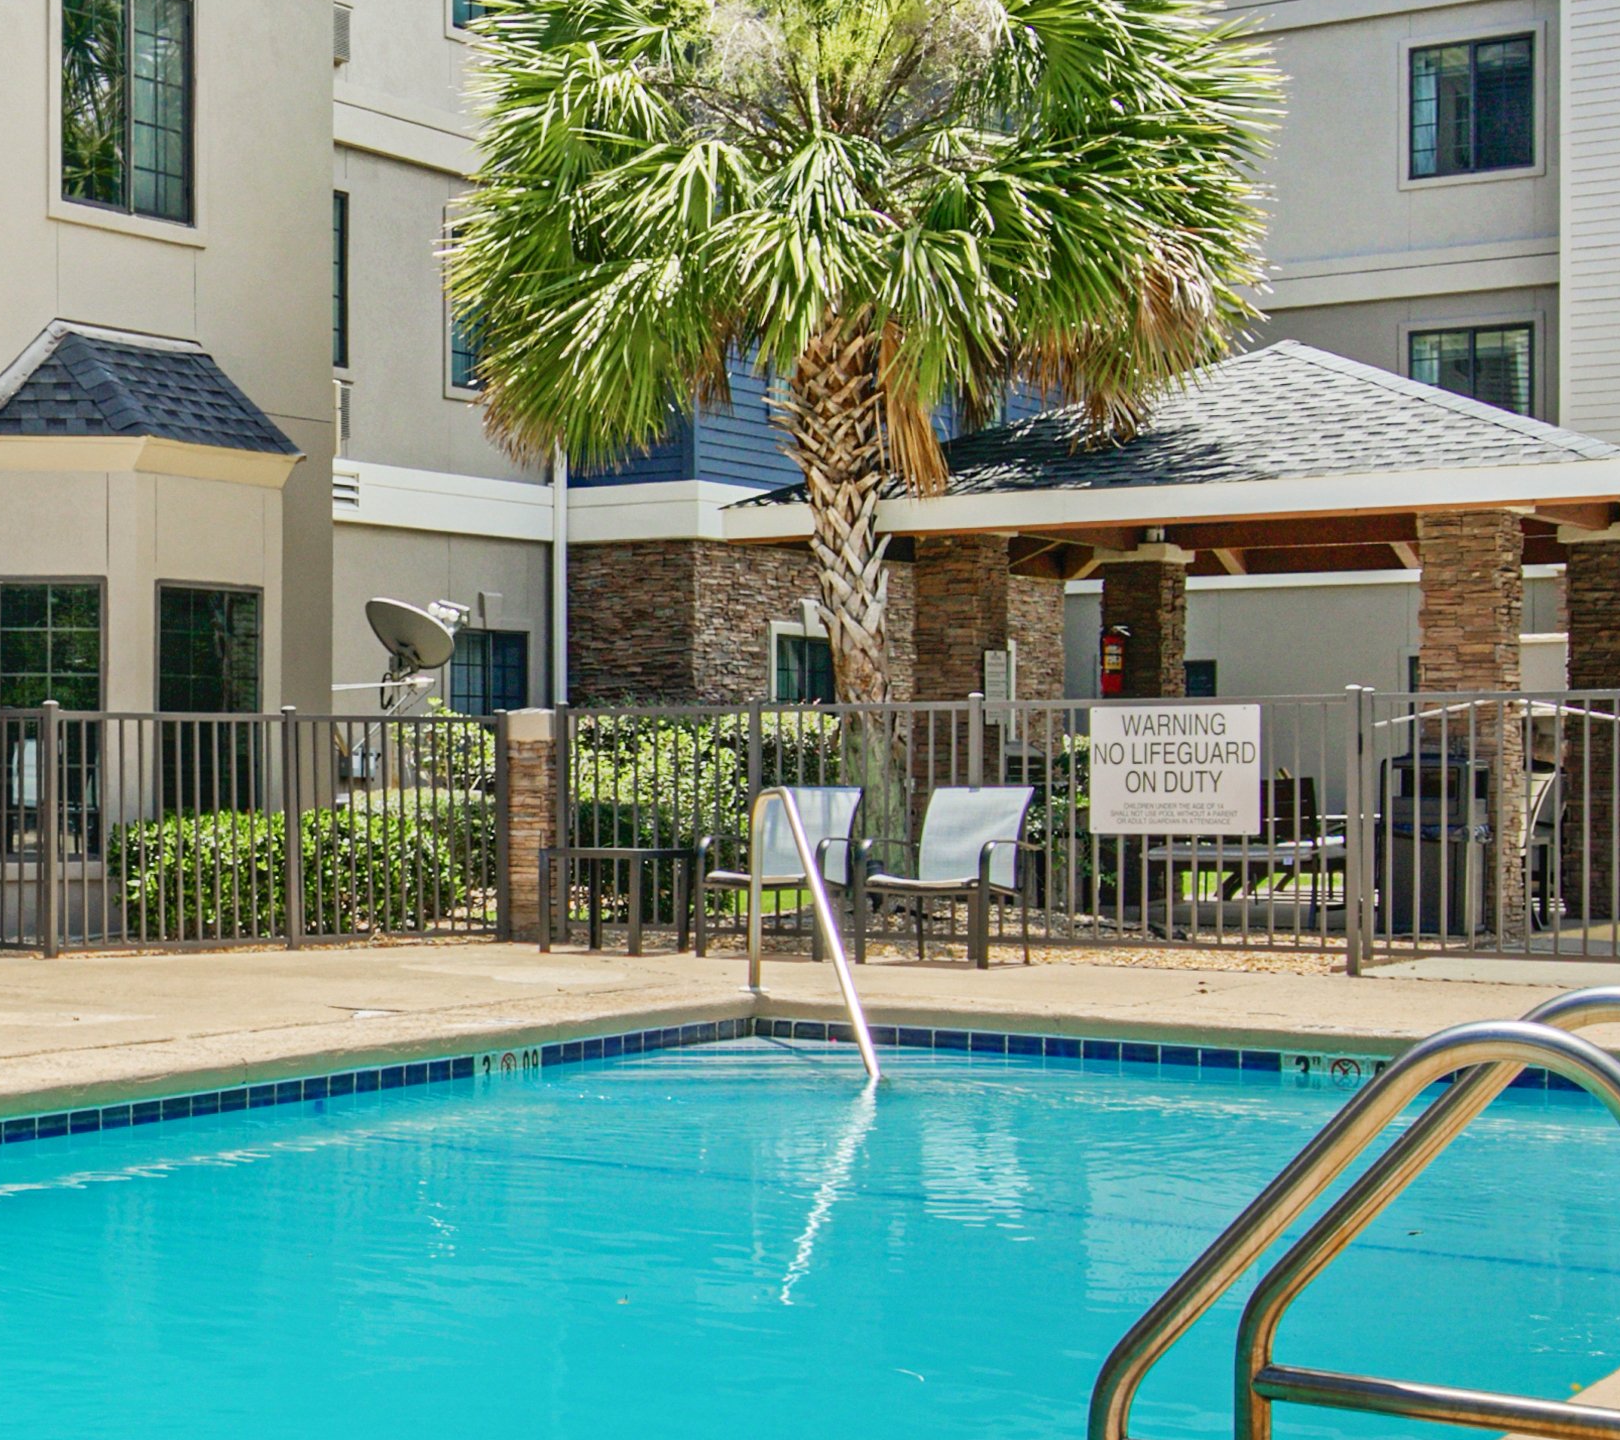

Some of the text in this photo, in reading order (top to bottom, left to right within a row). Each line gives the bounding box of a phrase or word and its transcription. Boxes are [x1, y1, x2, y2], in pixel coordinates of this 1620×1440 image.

[1122, 712, 1226, 736] WARNING
[1094, 742, 1256, 765] NO LIFEGUARD
[1125, 770, 1222, 793] ON DUTY
